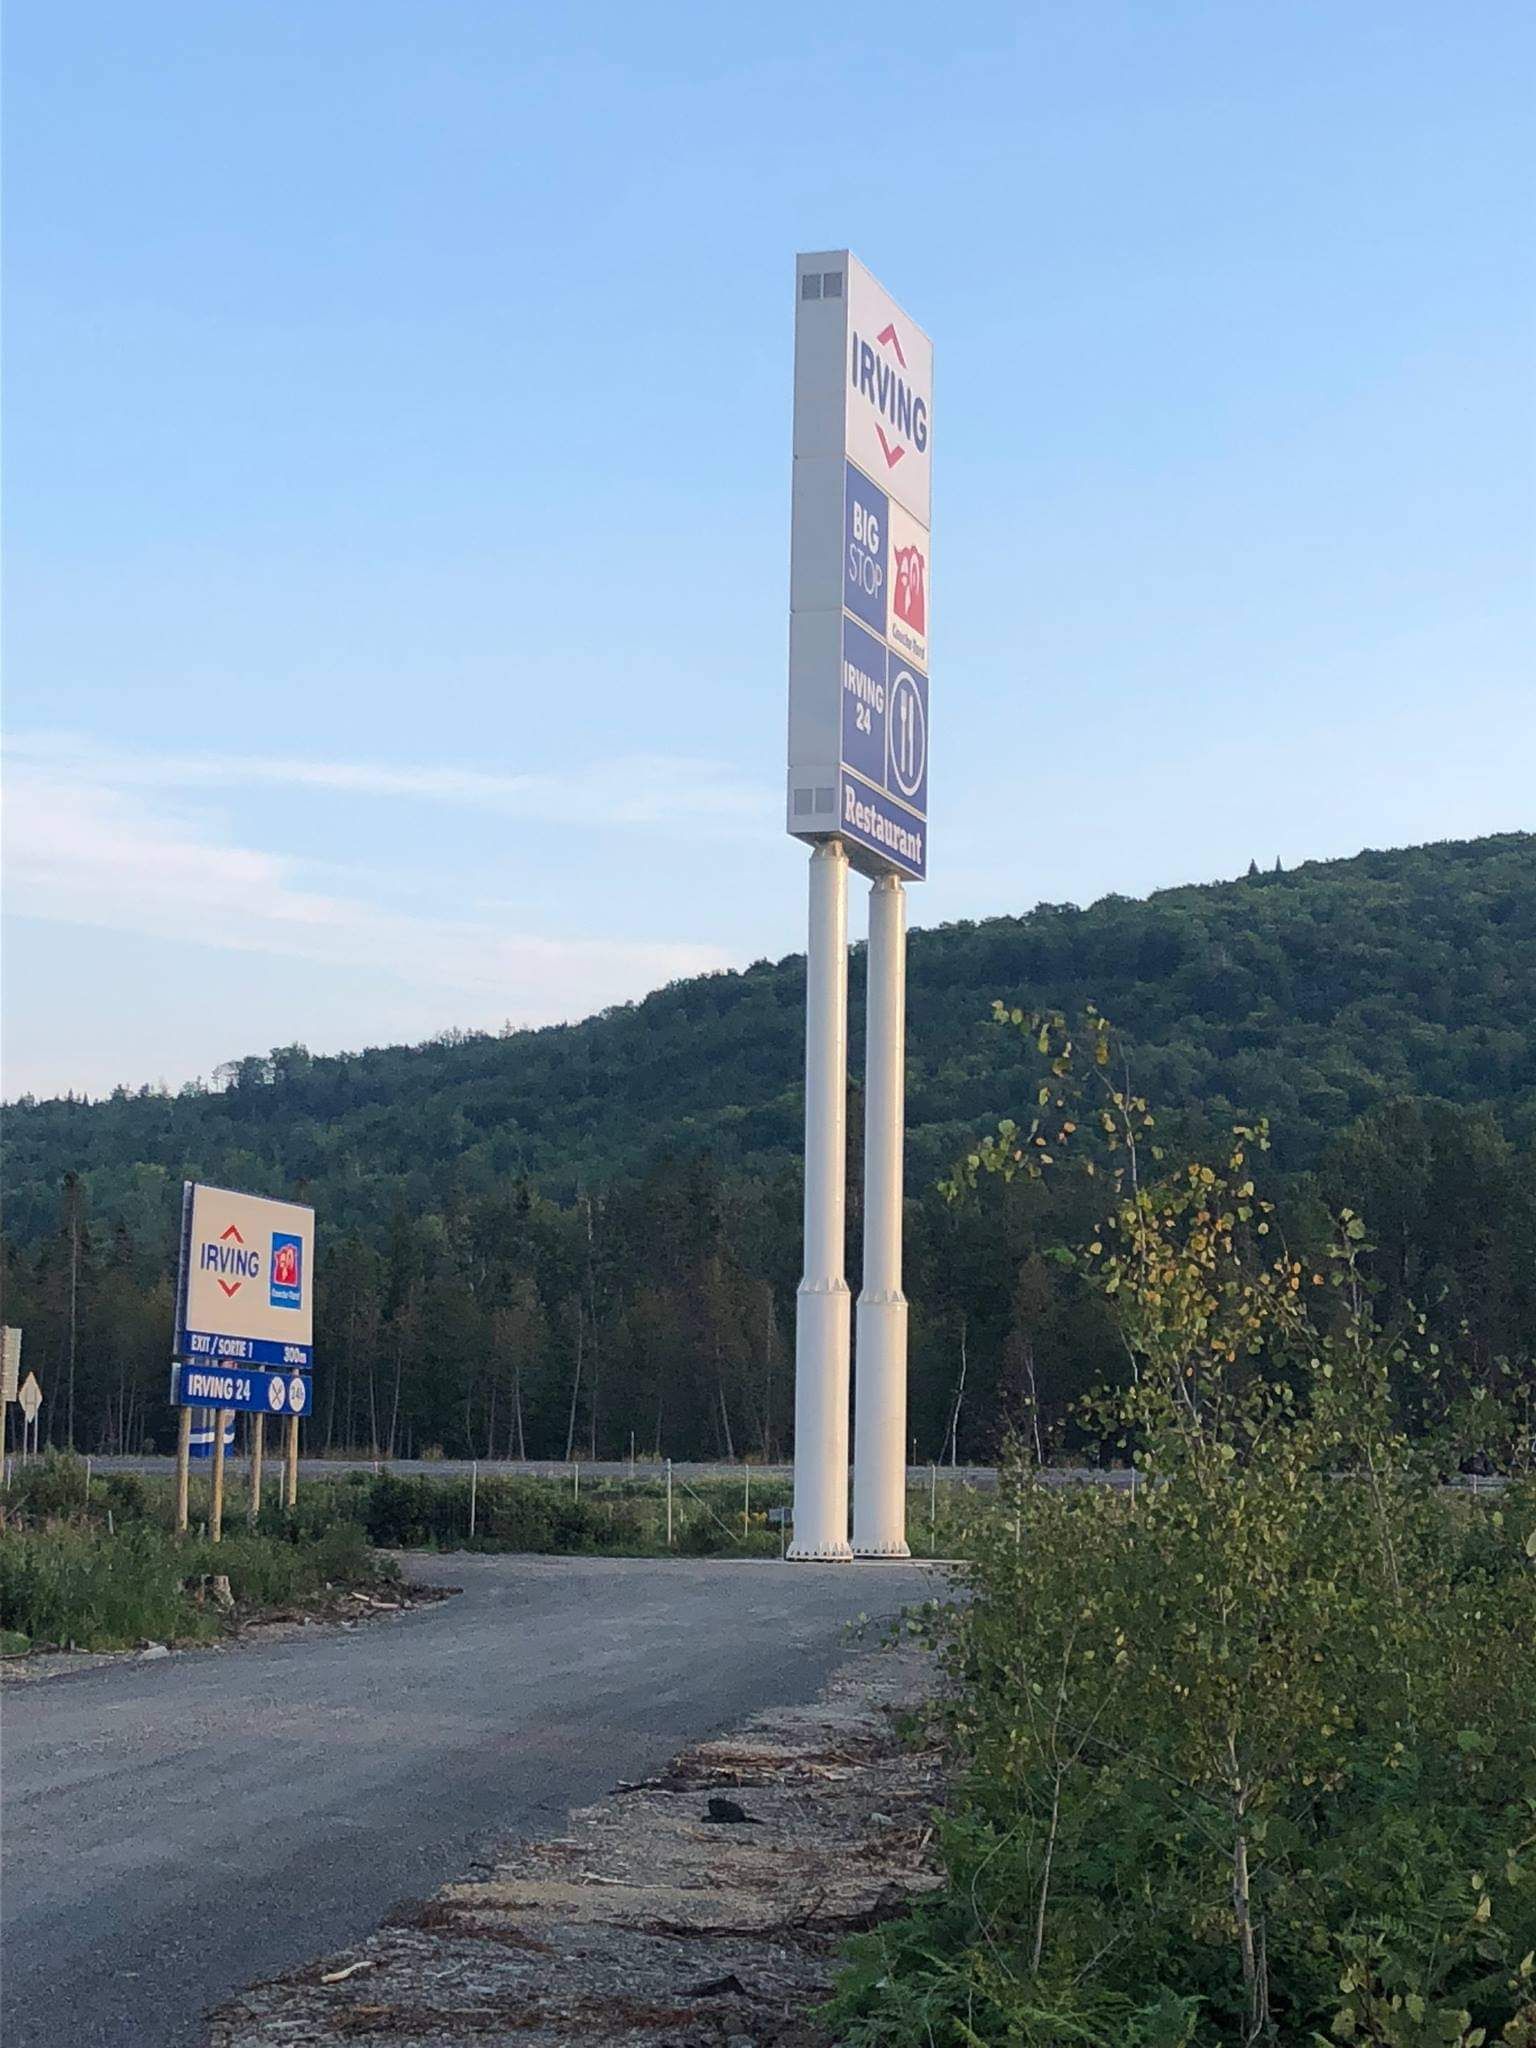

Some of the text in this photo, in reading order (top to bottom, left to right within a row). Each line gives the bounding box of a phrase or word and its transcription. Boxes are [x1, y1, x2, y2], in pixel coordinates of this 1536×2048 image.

[852, 331, 927, 453] IRVING
[853, 501, 879, 554] BIG
[849, 543, 883, 599] STOP
[844, 660, 884, 714] IRVING
[856, 702, 872, 735] 24
[844, 784, 922, 865] Restaurant
[200, 1242, 260, 1278] IRVING
[191, 1334, 211, 1353] EXIT
[218, 1338, 247, 1357] SORTIE
[187, 1374, 251, 1402] IRVING 24
